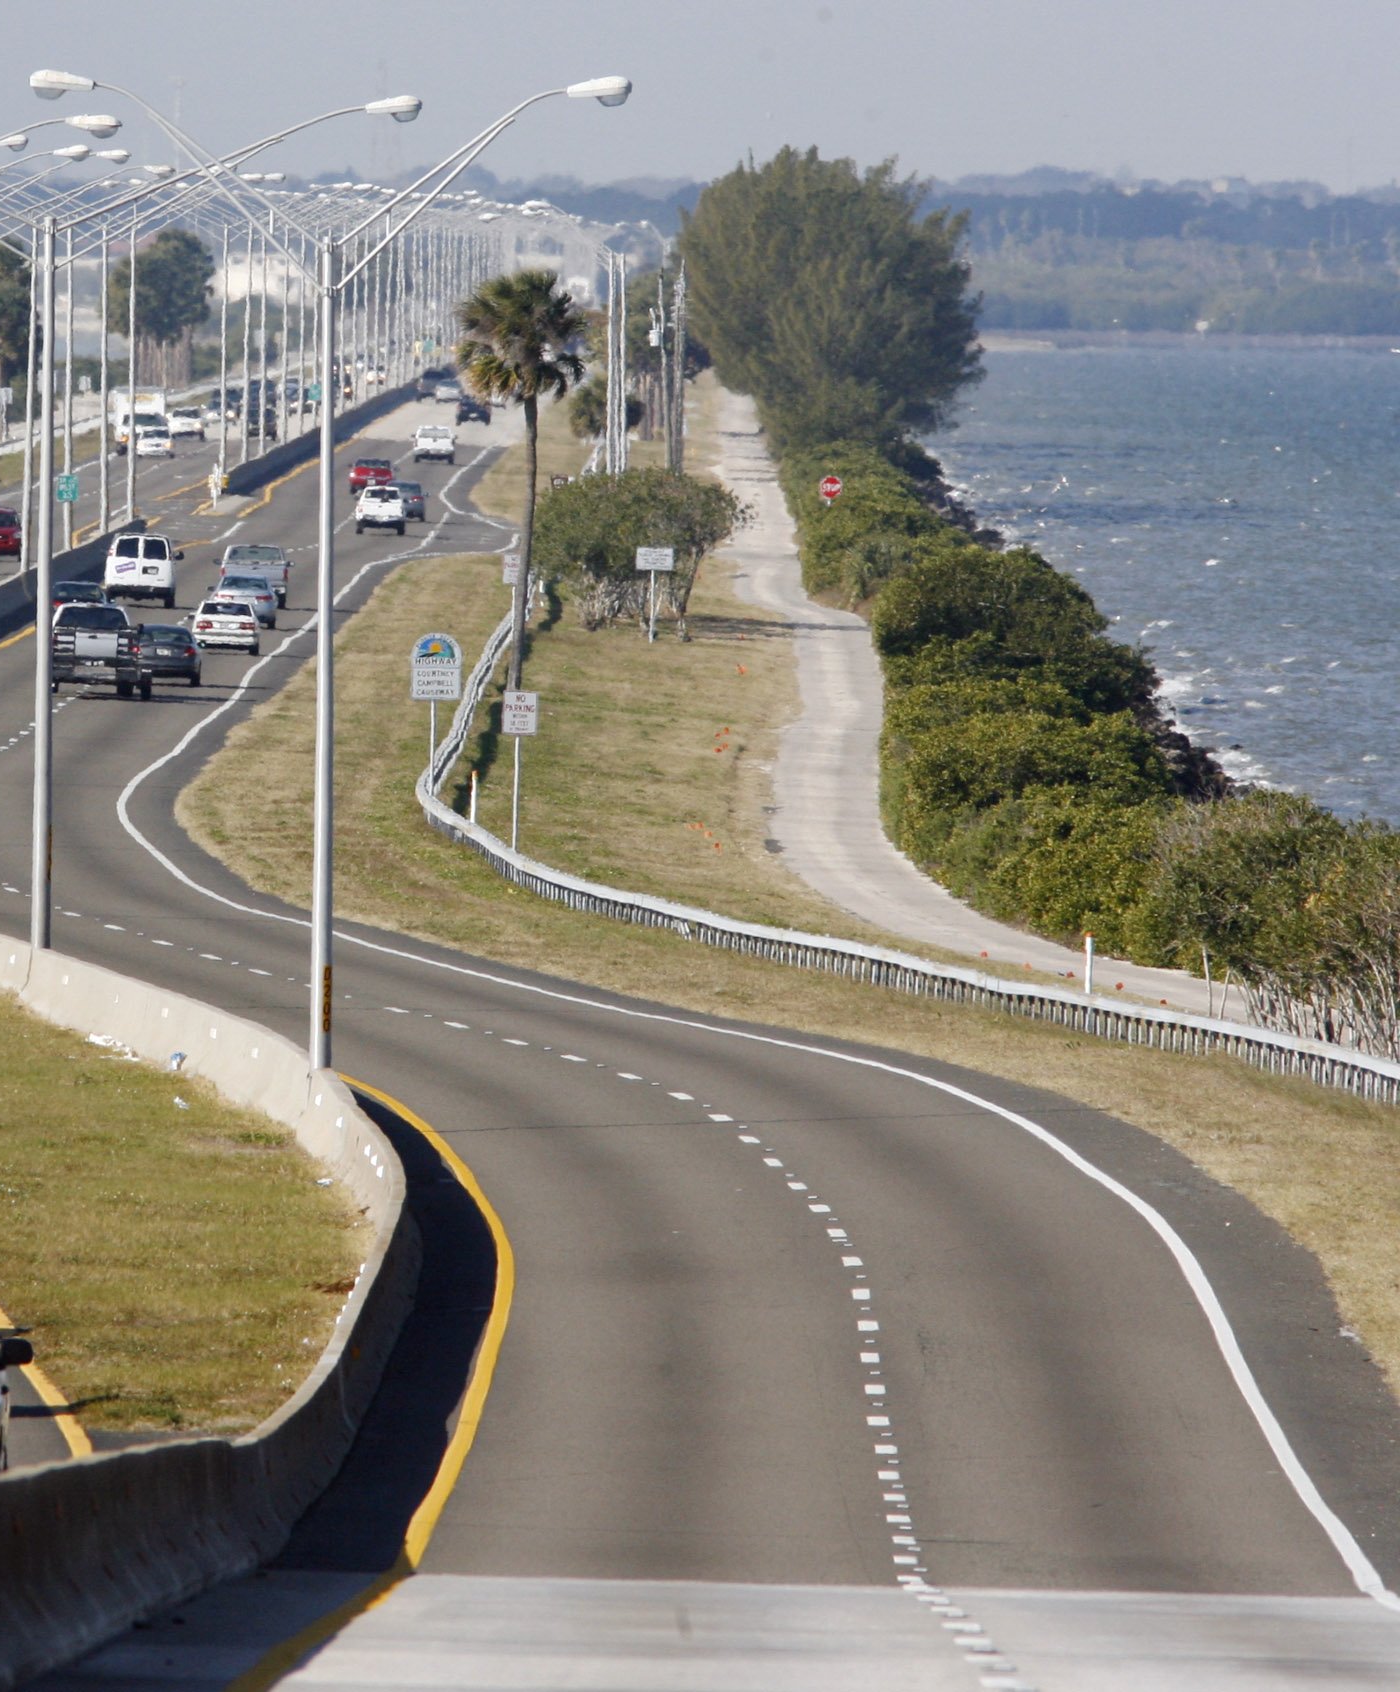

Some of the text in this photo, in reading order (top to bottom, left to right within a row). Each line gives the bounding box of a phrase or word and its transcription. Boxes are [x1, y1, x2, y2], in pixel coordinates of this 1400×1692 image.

[822, 483, 841, 492] STOP
[417, 679, 454, 687] CAMPBELL
[416, 688, 454, 696] CAUSEWAY
[516, 694, 526, 703] NO
[505, 703, 535, 713] PARKING
